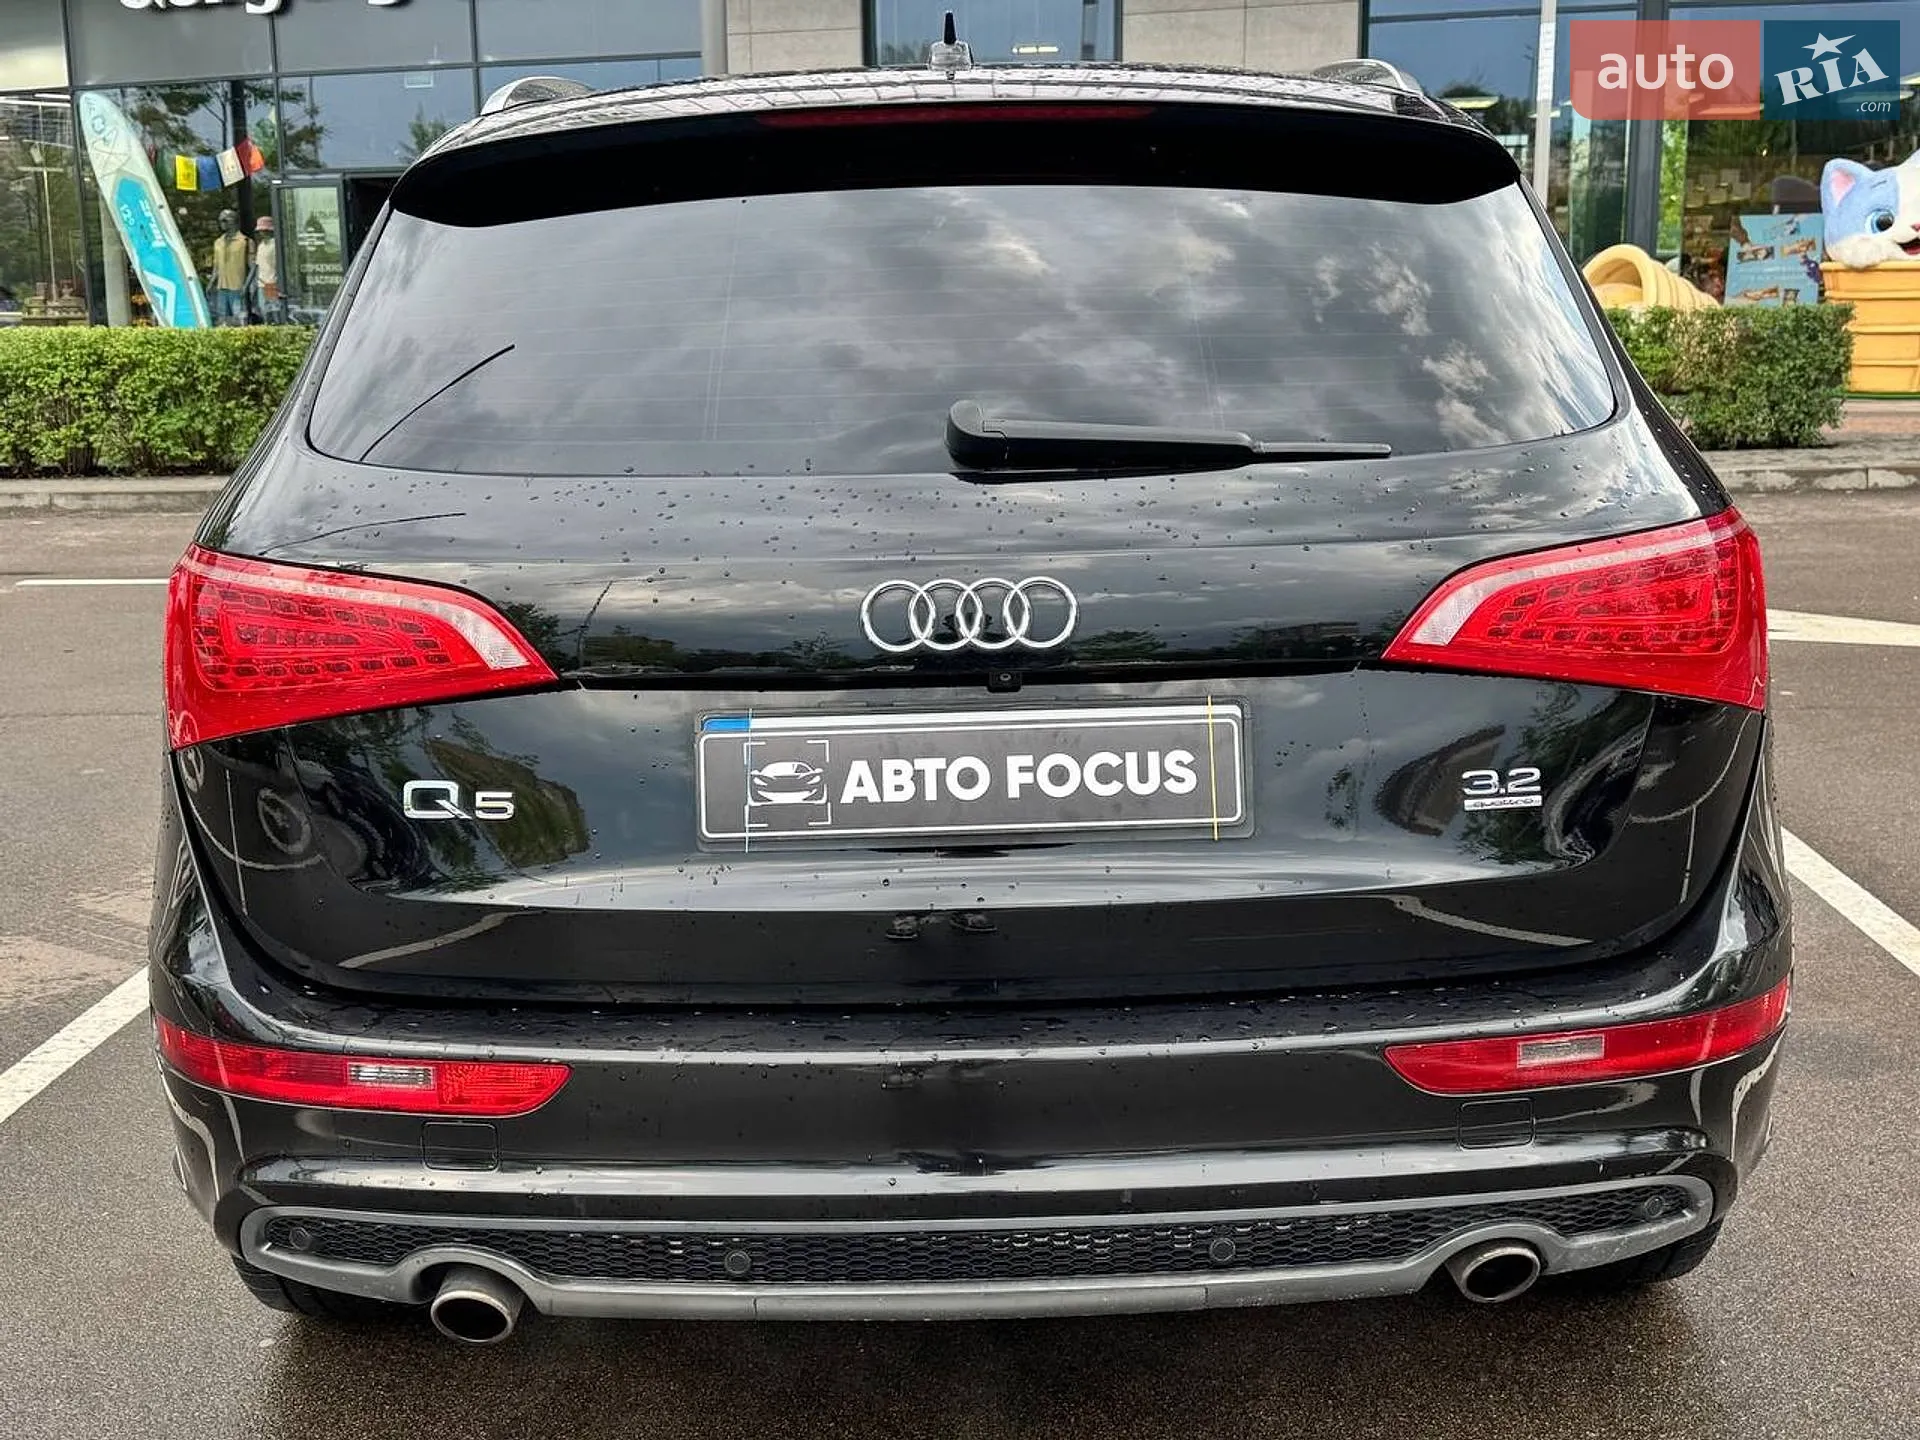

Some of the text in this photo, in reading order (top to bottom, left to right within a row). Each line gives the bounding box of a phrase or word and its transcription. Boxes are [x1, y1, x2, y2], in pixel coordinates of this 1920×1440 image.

[840, 749, 1198, 805] АВТО FOCUS
[1462, 767, 1541, 795] 3.2
[403, 780, 515, 821] Q5
